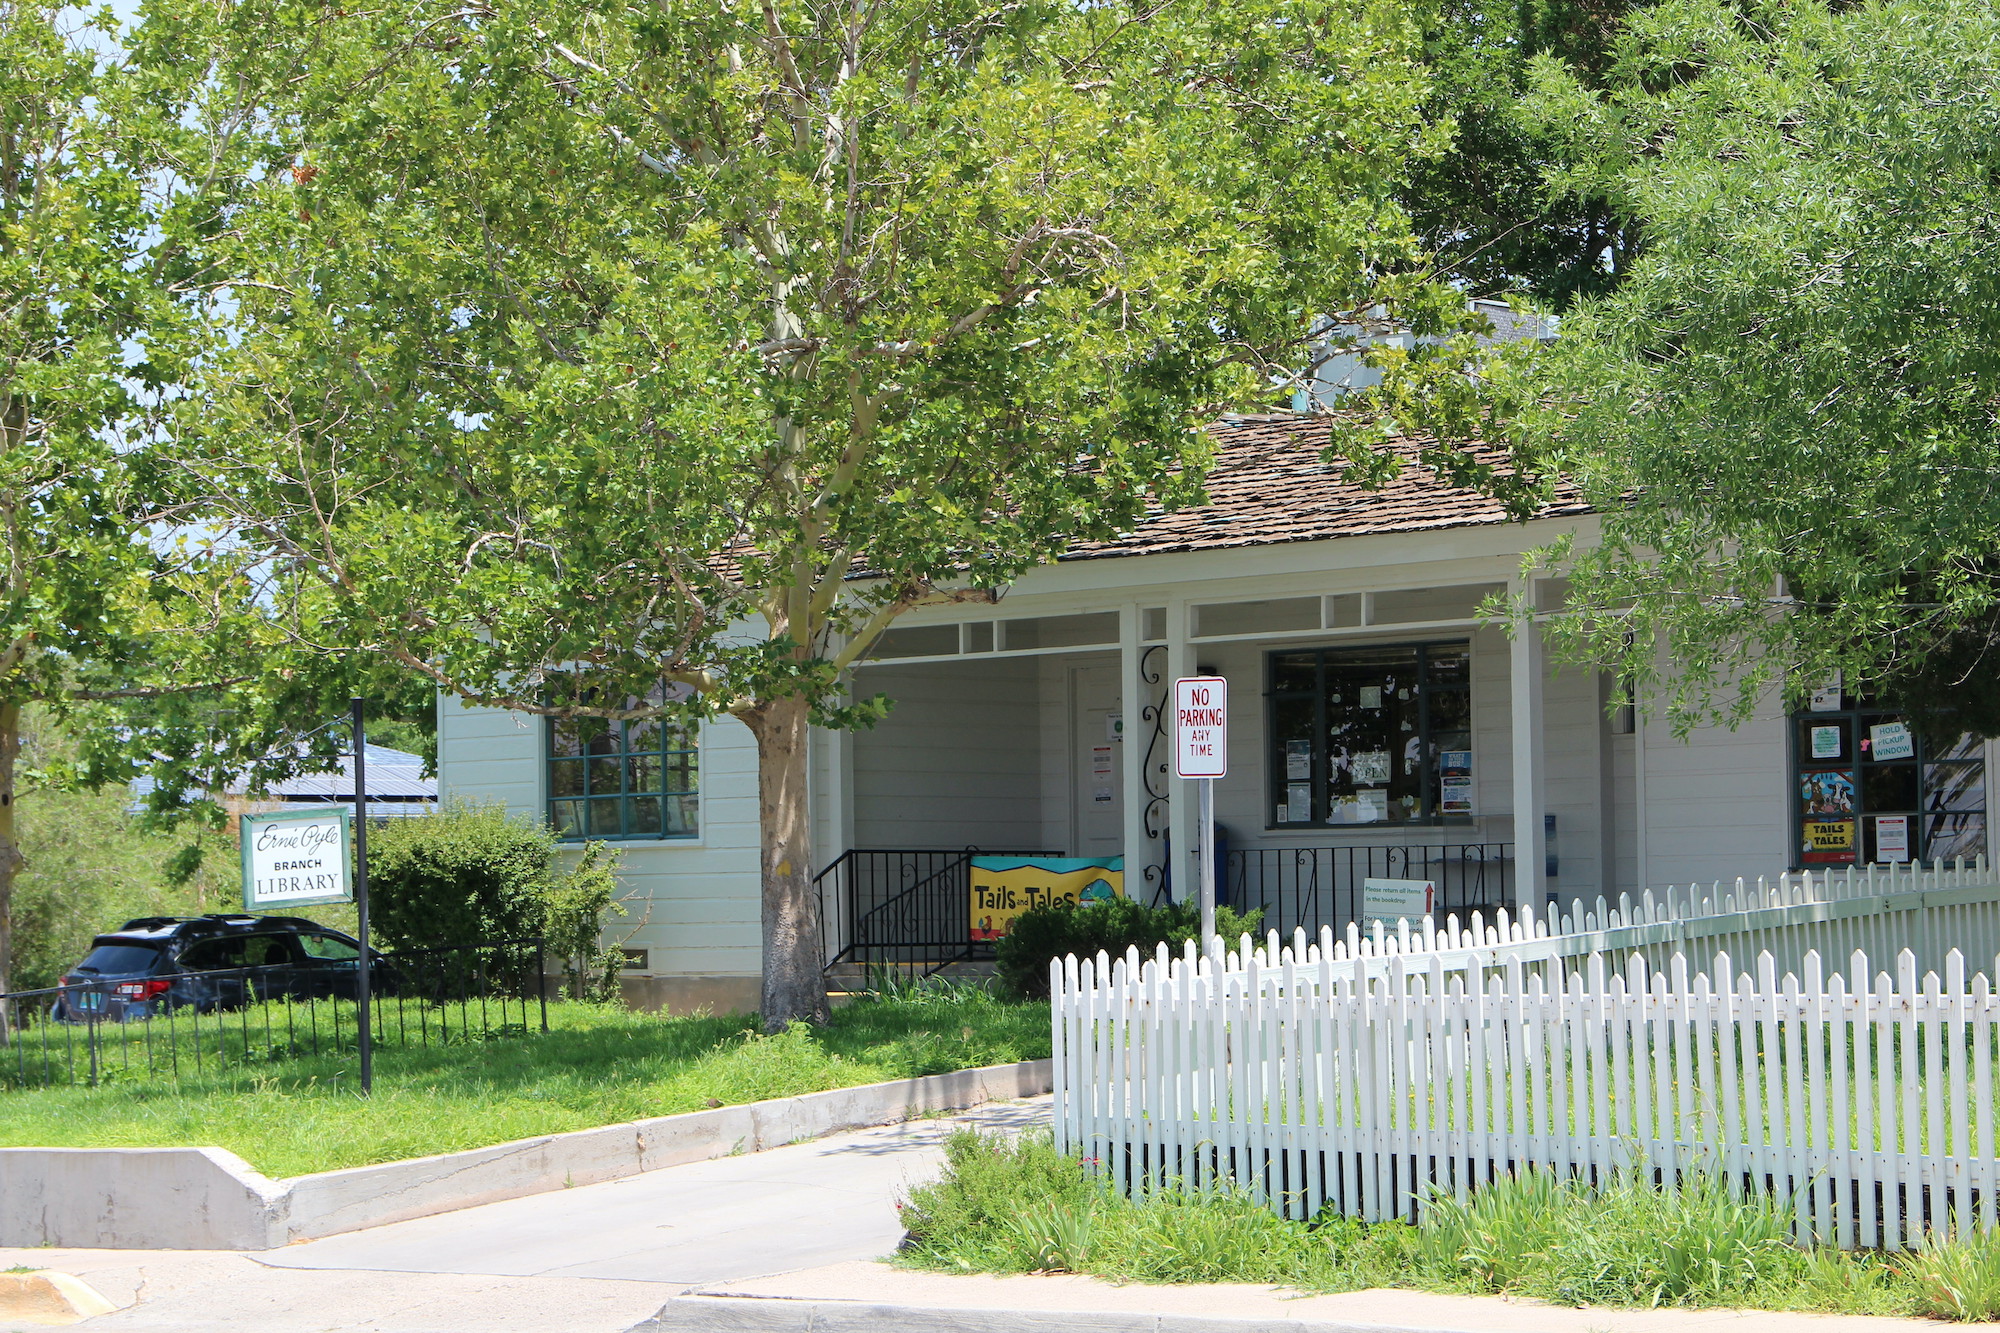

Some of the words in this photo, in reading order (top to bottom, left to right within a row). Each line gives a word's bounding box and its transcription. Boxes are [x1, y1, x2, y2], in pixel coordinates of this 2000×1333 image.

[1192, 688, 1210, 706] NO
[1180, 708, 1222, 727] PARKING
[1192, 729, 1211, 742] ANY
[1879, 725, 1901, 735] HOLD
[1877, 735, 1905, 746] PICKUP
[1190, 744, 1213, 756] TIME
[1875, 745, 1910, 757] WINDOW
[1813, 824, 1845, 833] TAILS
[257, 824, 299, 851] Ernie
[300, 825, 338, 856] Pyle
[1814, 836, 1846, 845] TALES
[274, 859, 322, 871] BRANCH
[257, 873, 339, 895] LIBRARY
[974, 885, 1016, 910] Tails
[1016, 897, 1029, 906] and
[1025, 887, 1075, 911] Tales
